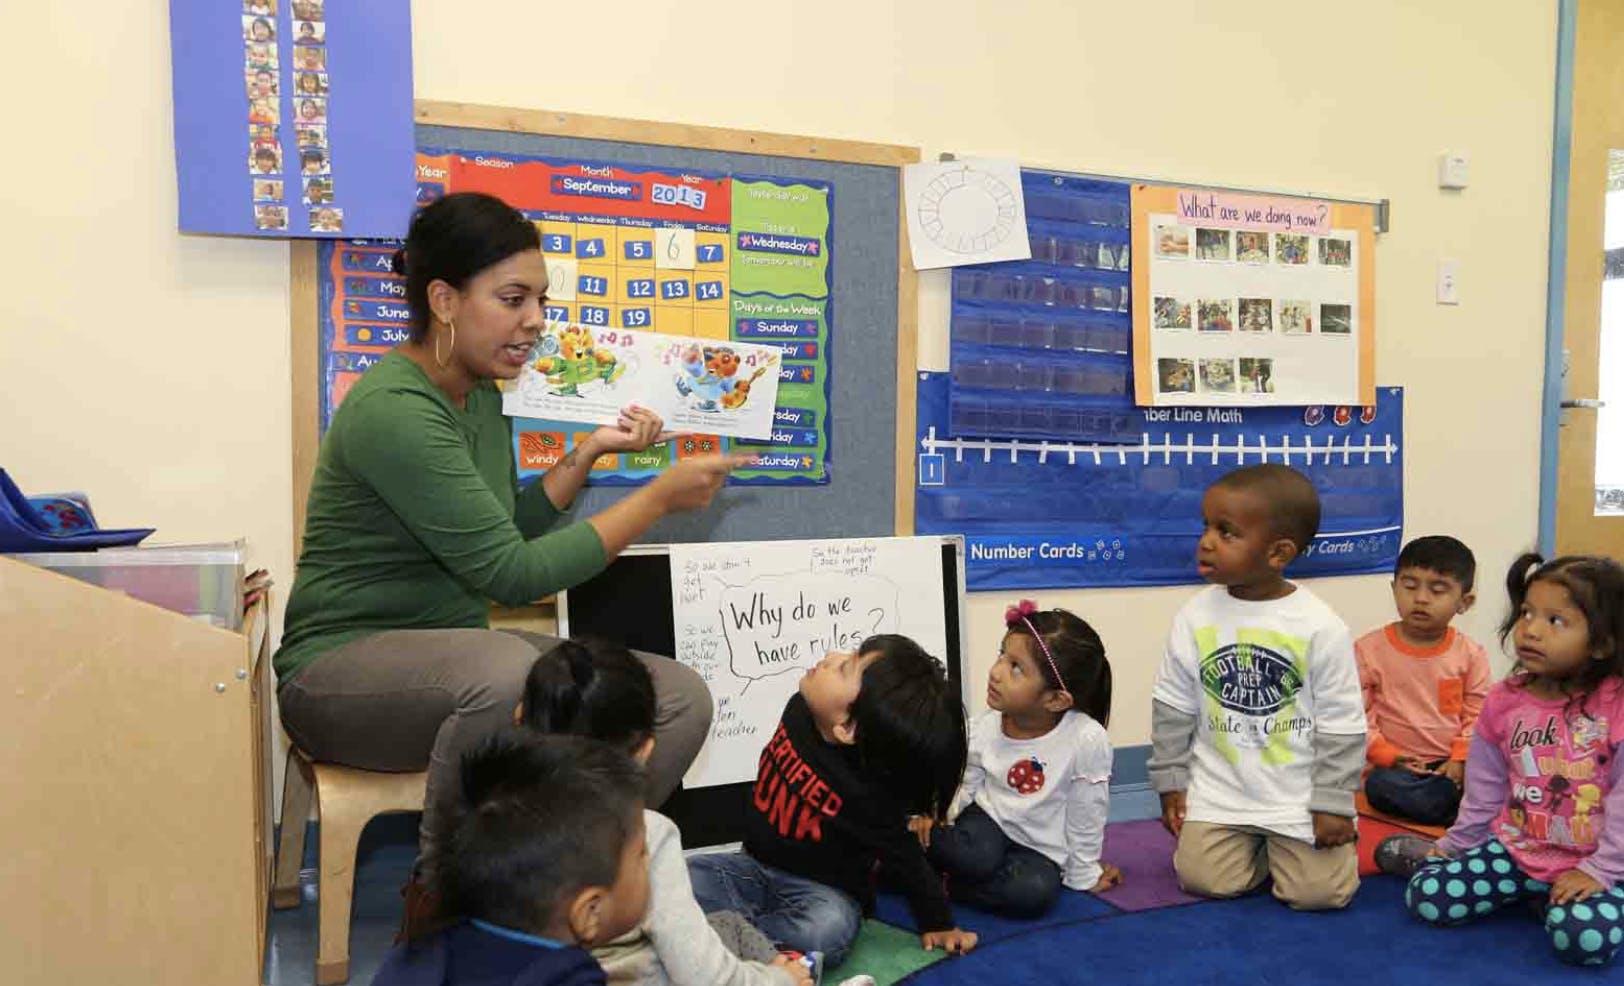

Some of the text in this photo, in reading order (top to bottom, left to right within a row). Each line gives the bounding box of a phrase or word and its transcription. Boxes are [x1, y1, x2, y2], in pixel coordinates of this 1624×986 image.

[475, 156, 514, 169] Season
[418, 165, 447, 178] Year
[581, 165, 614, 178] Month
[681, 173, 703, 184] Year
[563, 178, 632, 195] September
[653, 185, 704, 207] 2013
[1180, 193, 1217, 219] What
[1220, 208, 1239, 221] are
[1245, 210, 1262, 223] we
[542, 211, 571, 222] Tuesday
[577, 215, 616, 226] Wednesday
[620, 217, 652, 227] Thursday
[663, 220, 685, 230] Friday
[696, 222, 727, 233] Saturday
[551, 233, 716, 260] 3 4 5 6 7
[751, 235, 808, 254] Wednesday
[380, 281, 406, 296] May
[584, 277, 601, 293] 11
[633, 281, 651, 296] 12
[667, 281, 685, 296] 13
[700, 283, 719, 298] 14
[377, 306, 409, 320] June
[544, 307, 645, 325] 17 18 19
[734, 300, 822, 316] Days of the Week
[757, 321, 799, 335] Sunday
[381, 330, 410, 343] July
[781, 343, 799, 356] day
[774, 409, 800, 424] sday
[1144, 407, 1243, 423] ber Line Math
[770, 429, 794, 444] iday
[526, 454, 559, 466] windy
[634, 454, 662, 467] rainy
[971, 542, 1084, 559] Number Cards
[1318, 540, 1354, 554] Cards
[730, 590, 852, 638] Why do we
[754, 641, 801, 665] have
[1203, 655, 1272, 684] FOOTBALL
[1221, 682, 1282, 706] CAPTAIN
[1208, 716, 1241, 733] State
[1264, 716, 1313, 737] Champs
[1510, 716, 1556, 749] look
[1513, 782, 1543, 803] we
